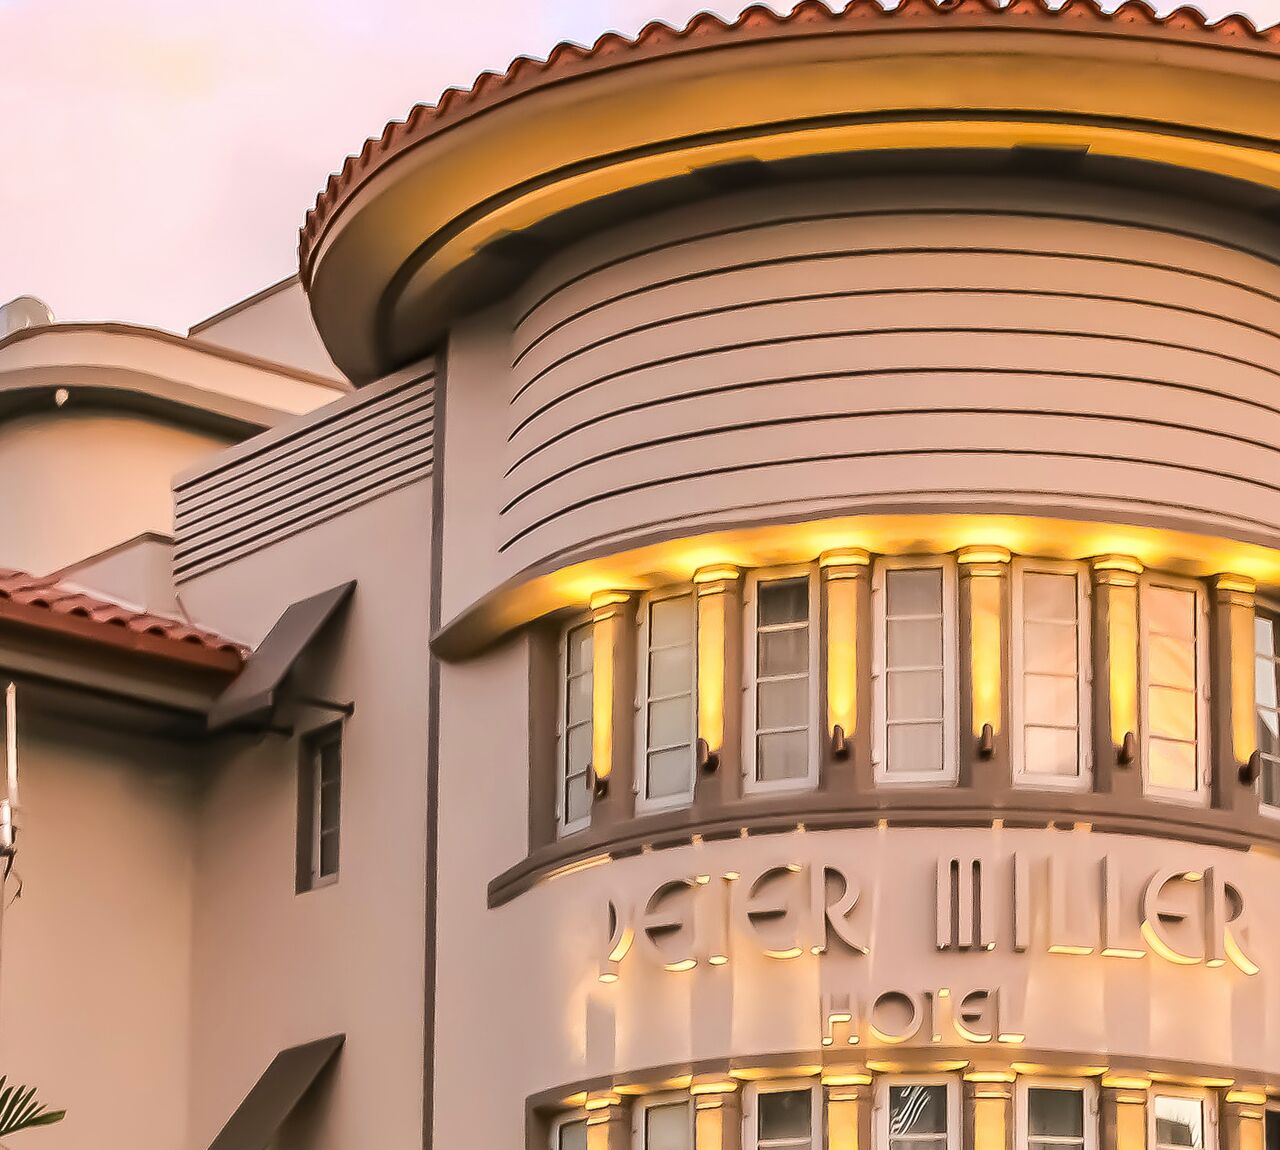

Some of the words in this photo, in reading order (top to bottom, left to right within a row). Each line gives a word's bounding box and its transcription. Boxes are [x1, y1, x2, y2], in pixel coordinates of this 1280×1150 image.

[597, 863, 871, 983] PETER
[935, 850, 1261, 976] MILLER
[820, 986, 1026, 1046] HOTEL
